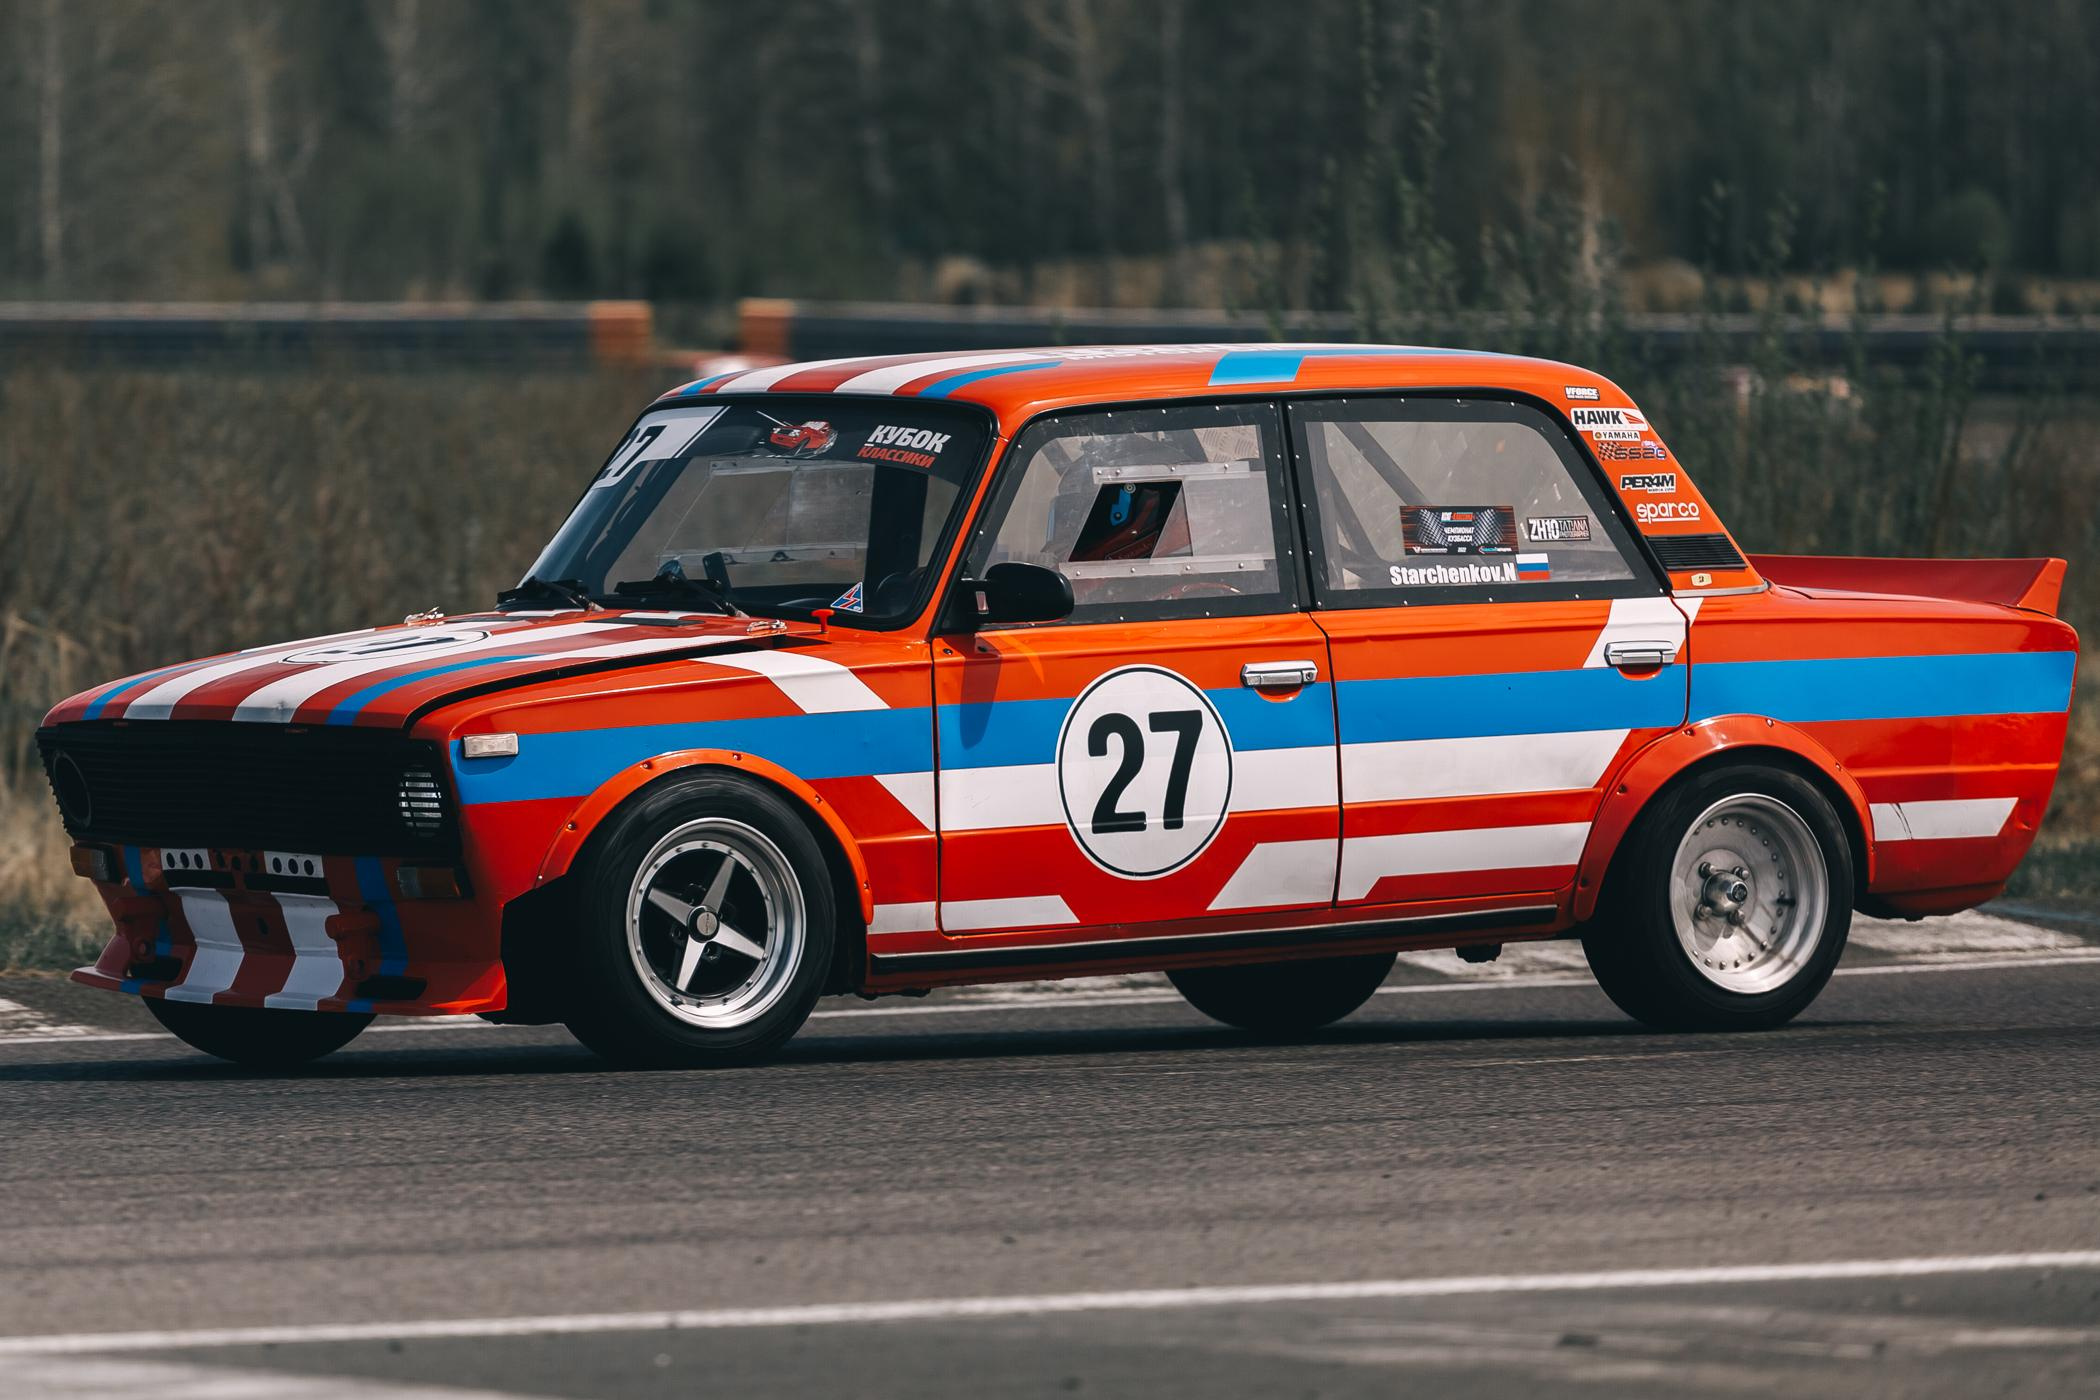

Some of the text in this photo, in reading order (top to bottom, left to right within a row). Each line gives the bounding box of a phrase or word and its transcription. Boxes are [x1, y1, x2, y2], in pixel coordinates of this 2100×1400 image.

[1573, 410, 1623, 425] HAWK
[867, 425, 952, 453] КУБОК
[1602, 432, 1639, 440] YAMAHA
[857, 446, 936, 468] КЛАССИКИ
[1636, 502, 1700, 524] sparco
[1389, 563, 1517, 585] Starchenkov.N
[1088, 709, 1203, 834] 27
